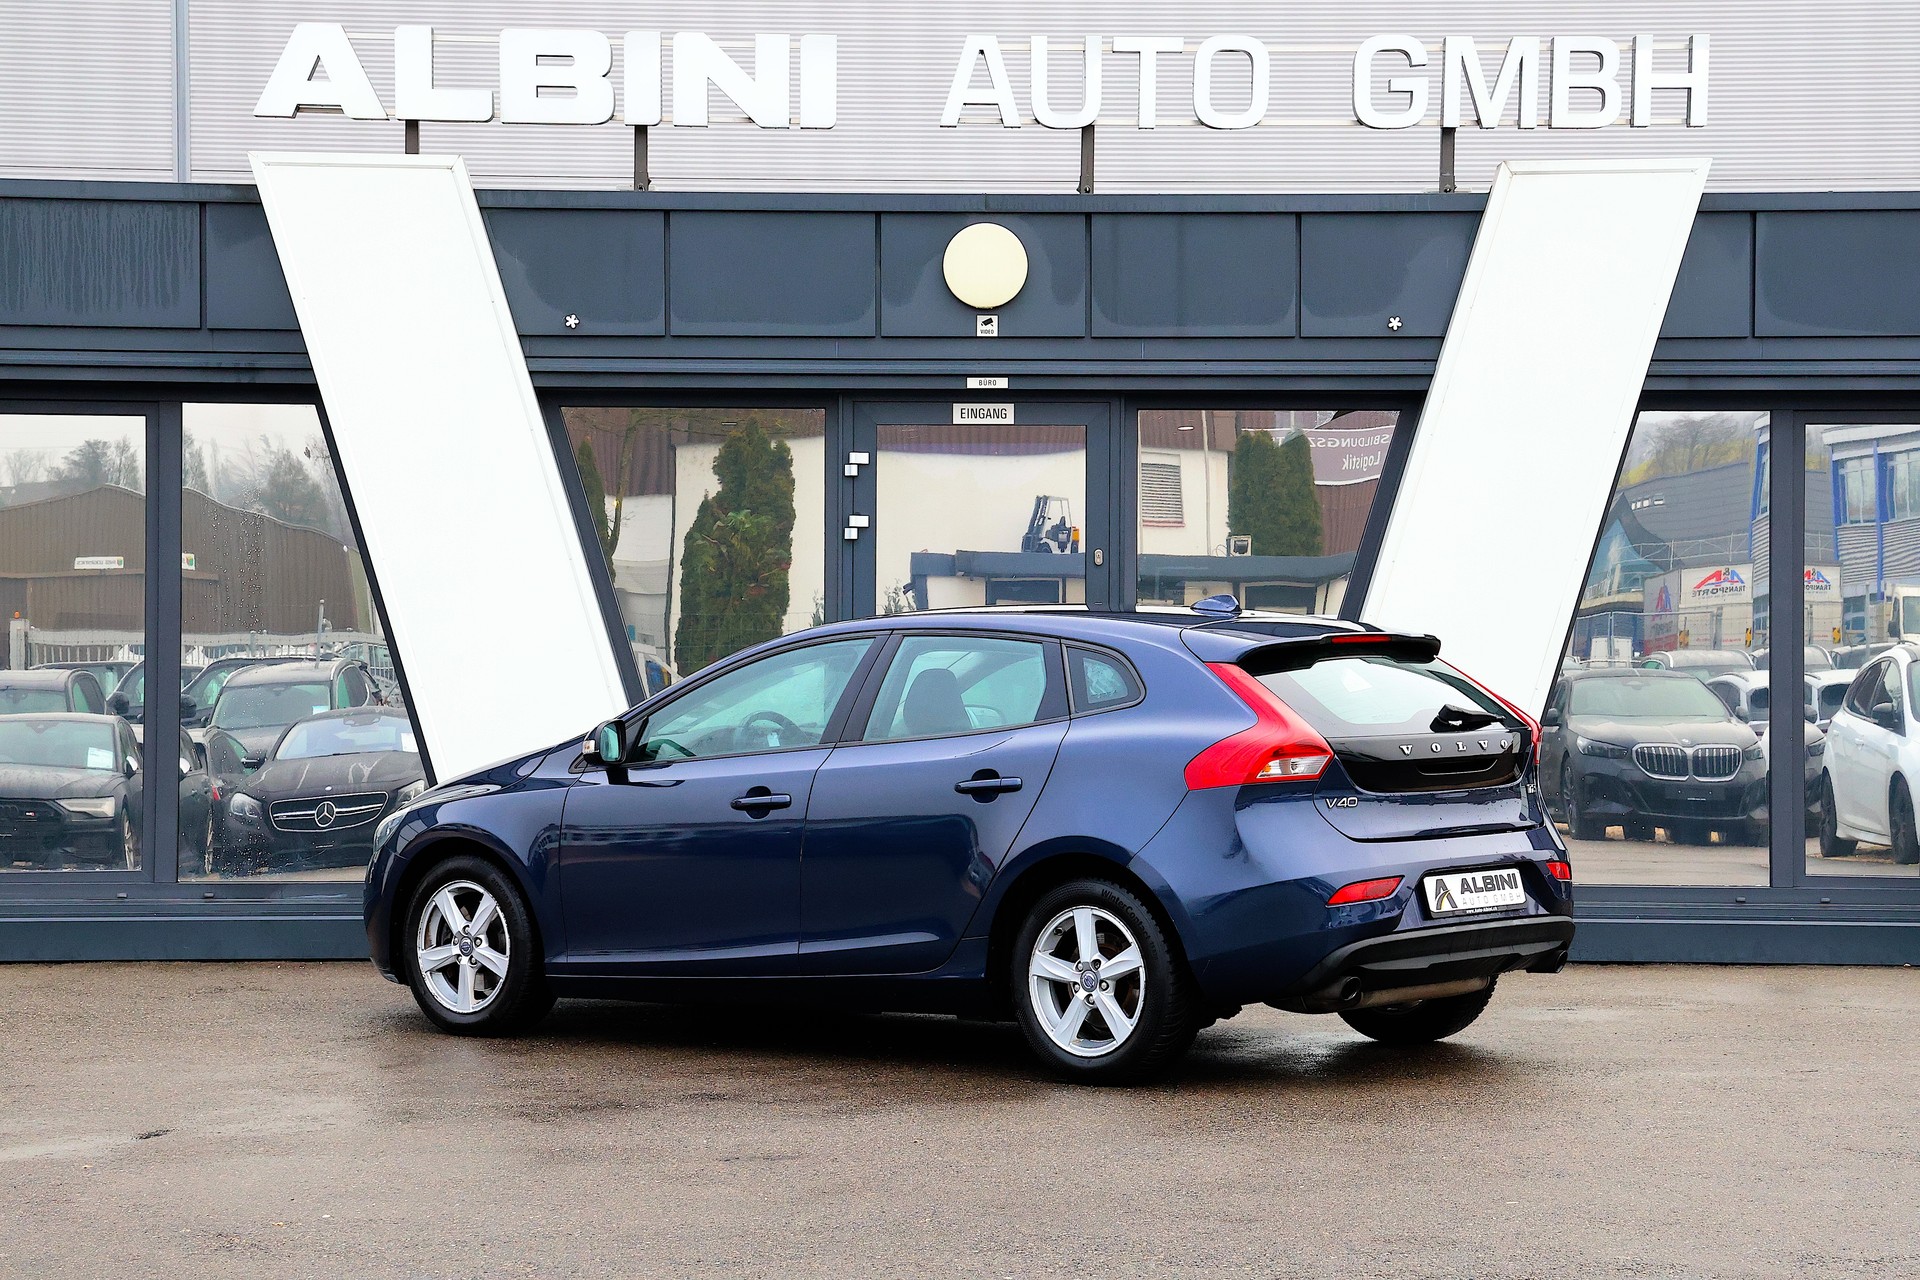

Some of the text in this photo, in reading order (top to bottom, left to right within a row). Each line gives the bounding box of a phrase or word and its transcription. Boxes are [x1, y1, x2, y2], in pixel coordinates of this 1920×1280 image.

[253, 22, 1711, 129] ALBINI AUTO GMBH
[978, 378, 997, 386] BÜRO
[960, 407, 1007, 419] EINGANG
[1400, 739, 1508, 756] VOLVO
[1326, 796, 1358, 808] V40
[1460, 873, 1518, 895] ALBINI
[1462, 892, 1521, 906] AUTO GMBH
[1101, 888, 1150, 940] WinterContact
